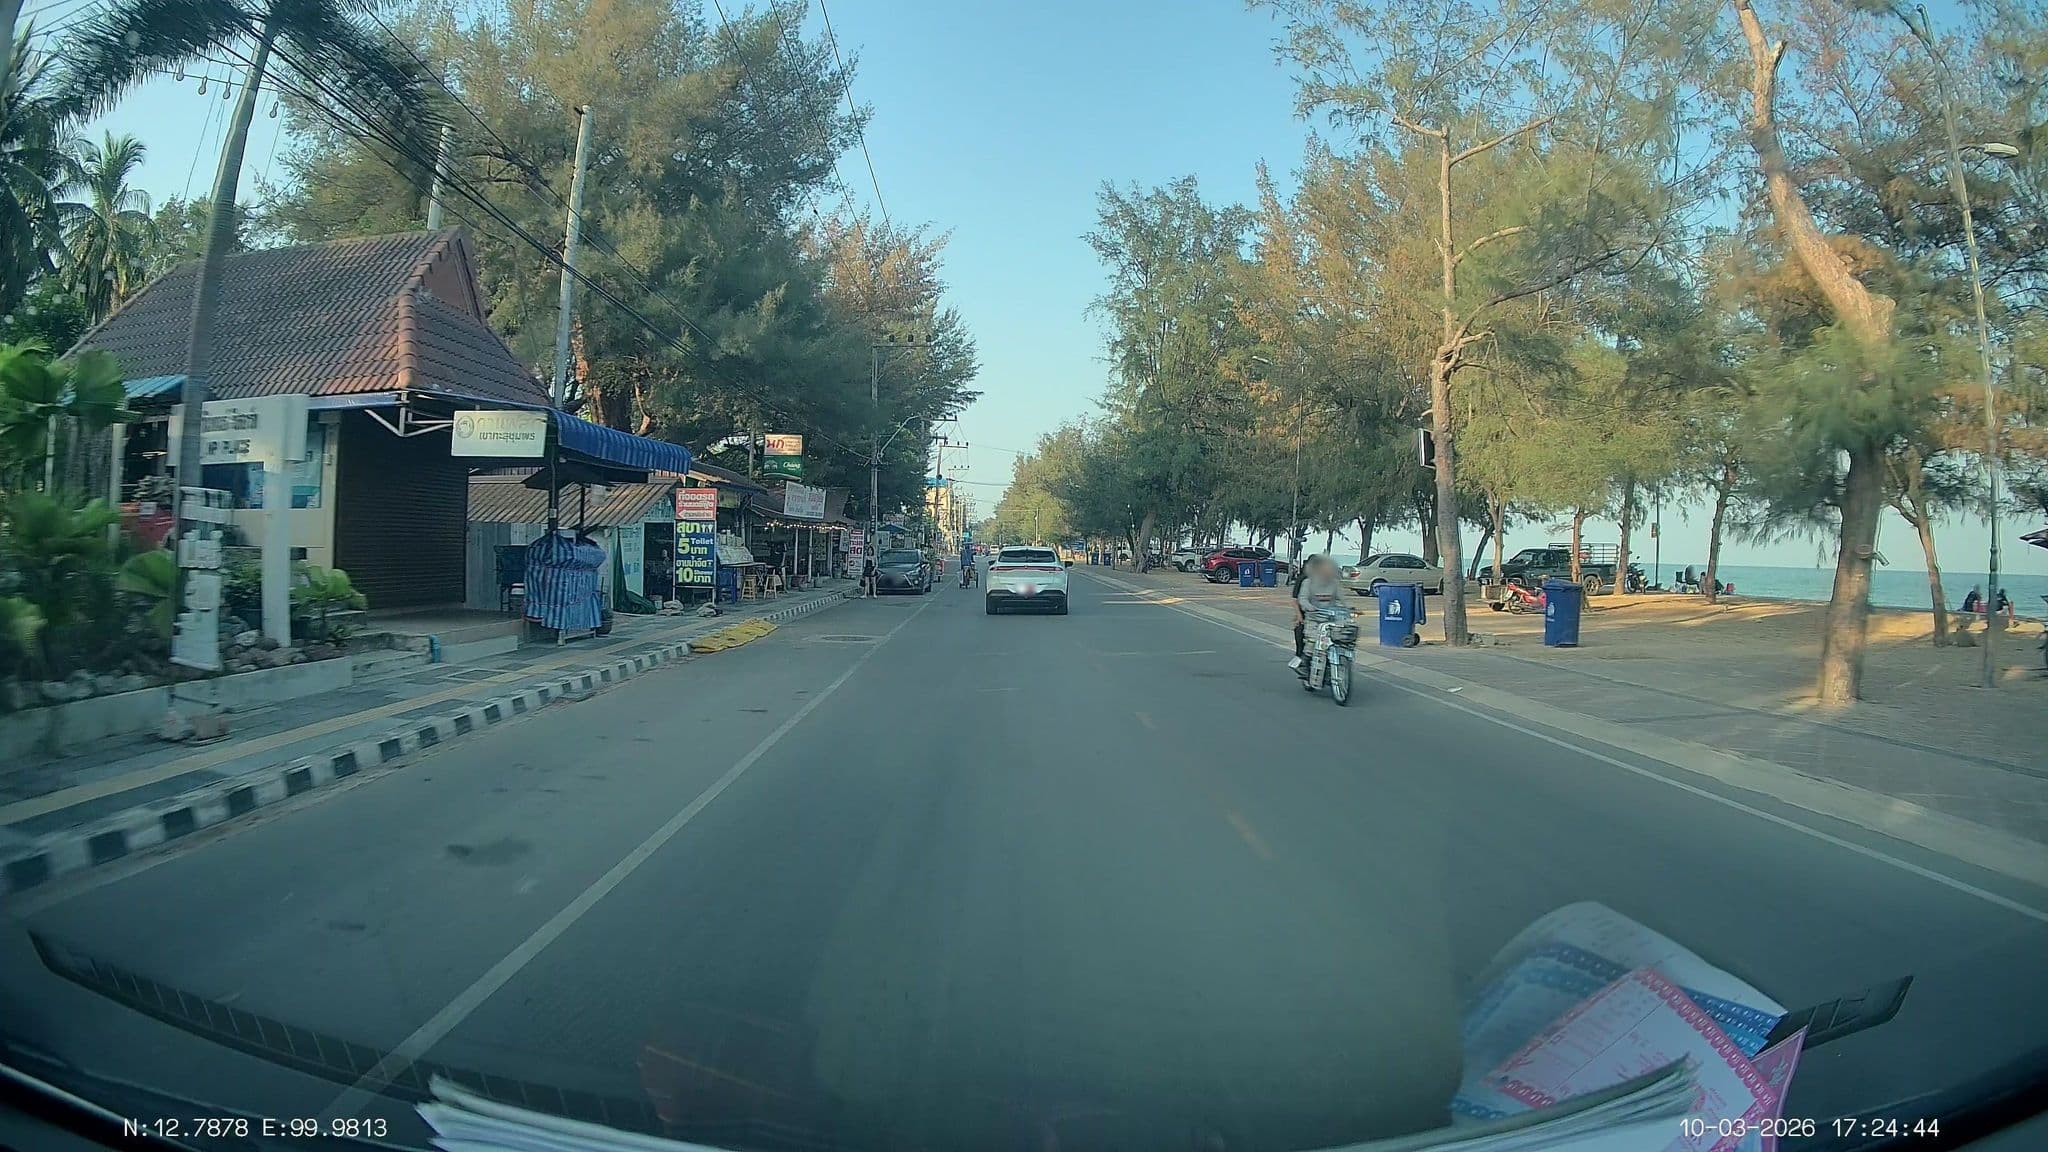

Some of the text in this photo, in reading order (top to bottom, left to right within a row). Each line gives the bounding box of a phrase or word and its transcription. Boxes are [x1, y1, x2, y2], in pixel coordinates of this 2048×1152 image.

[676, 521, 701, 537] สุขา
[677, 537, 708, 555] 5 บาท
[690, 537, 714, 545] Toilet
[676, 567, 712, 583] 10 บาท
